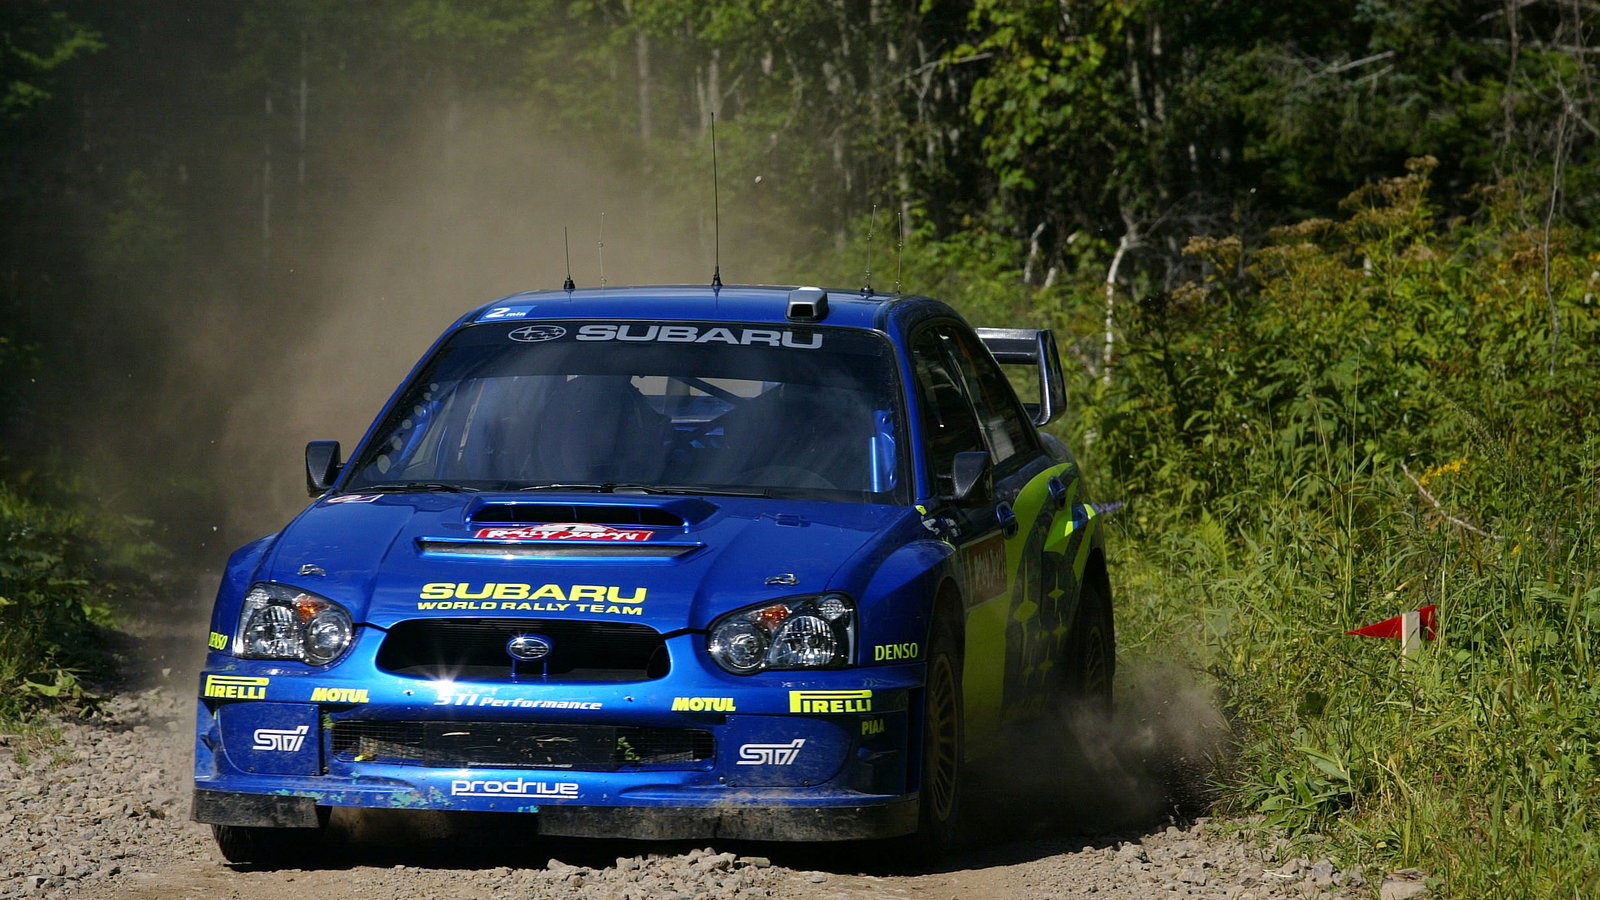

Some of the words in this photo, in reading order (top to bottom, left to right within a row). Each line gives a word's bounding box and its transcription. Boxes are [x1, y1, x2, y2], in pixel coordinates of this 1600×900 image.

[485, 307, 511, 318] 2
[576, 324, 823, 349] SUBARU
[419, 582, 647, 605] SUBARU
[417, 601, 499, 611] WORLD
[501, 602, 568, 612] RALLY
[575, 604, 643, 616] TEAM
[874, 642, 918, 661] DENSO
[204, 674, 270, 700] PIRELLI
[310, 687, 370, 703] MOTUL
[478, 697, 603, 710] Performance
[671, 697, 736, 712] MOTUL
[789, 689, 872, 713] PIRELLI
[861, 719, 885, 735] PIAA
[451, 777, 578, 797] prodrive
